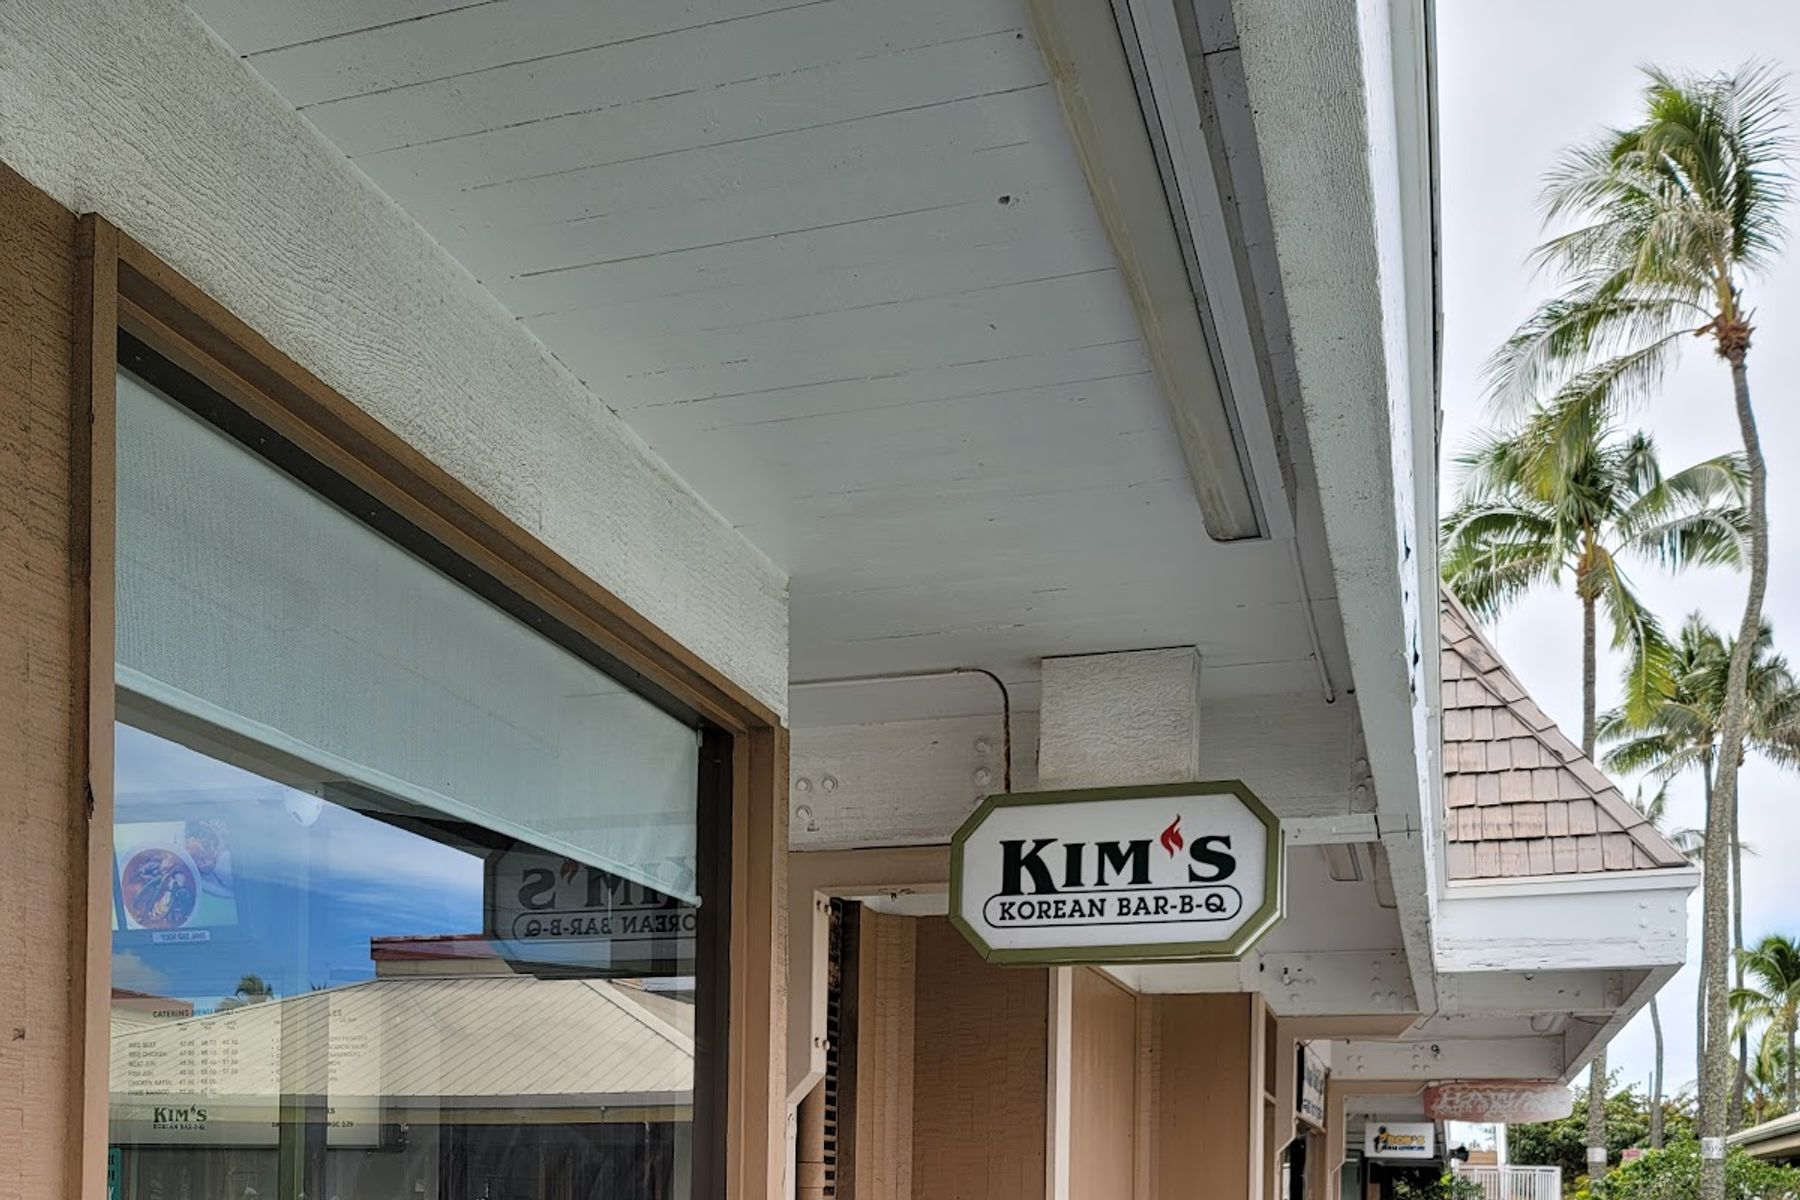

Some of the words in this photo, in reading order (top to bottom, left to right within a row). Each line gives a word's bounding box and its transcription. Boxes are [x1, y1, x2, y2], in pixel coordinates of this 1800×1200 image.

[999, 815, 1237, 896] KIM'S
[999, 898, 1106, 921] KOREAN
[1117, 893, 1227, 917] BAR-B-Q
[153, 1104, 207, 1123] KIM'S
